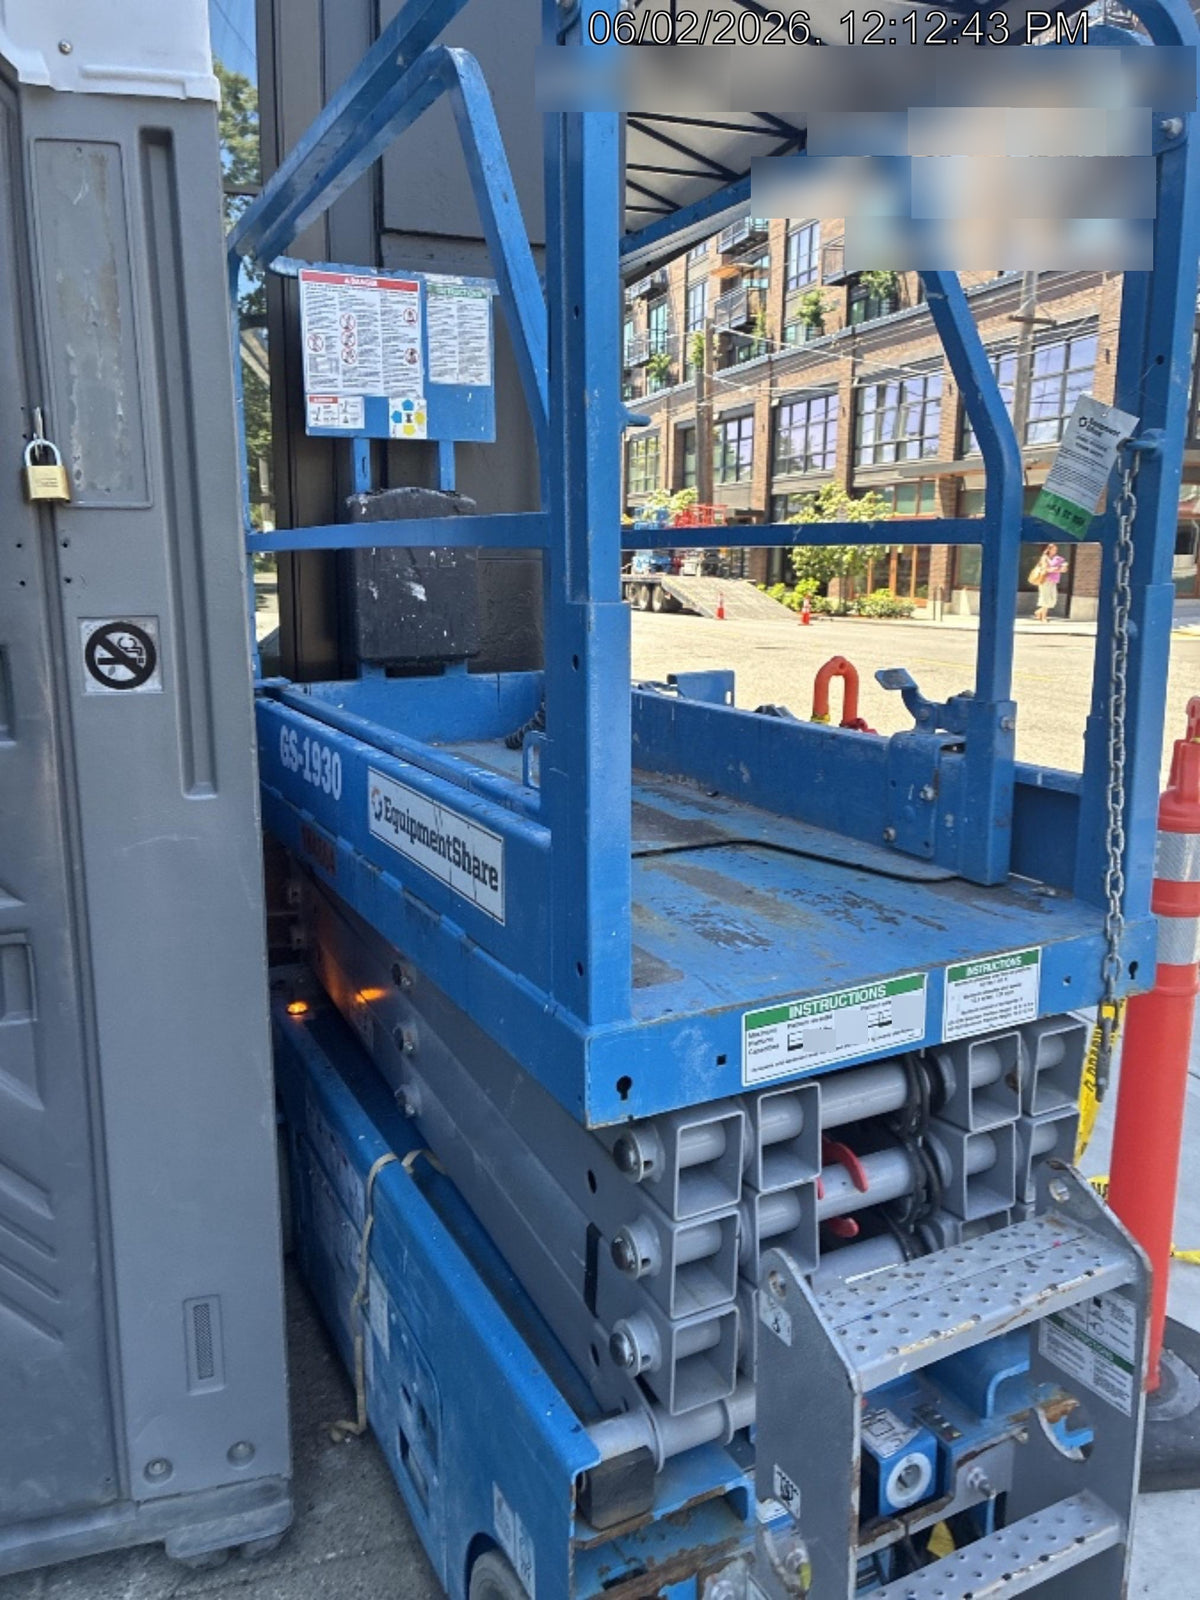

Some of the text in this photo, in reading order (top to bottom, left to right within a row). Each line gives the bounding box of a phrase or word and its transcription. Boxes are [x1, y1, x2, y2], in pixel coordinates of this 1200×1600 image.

[280, 726, 342, 800] GS-1930
[384, 796, 499, 891] EquipmentShare
[966, 956, 1022, 976] INSTRUCTIONS
[788, 985, 887, 1018] INSTRUCTIONS
